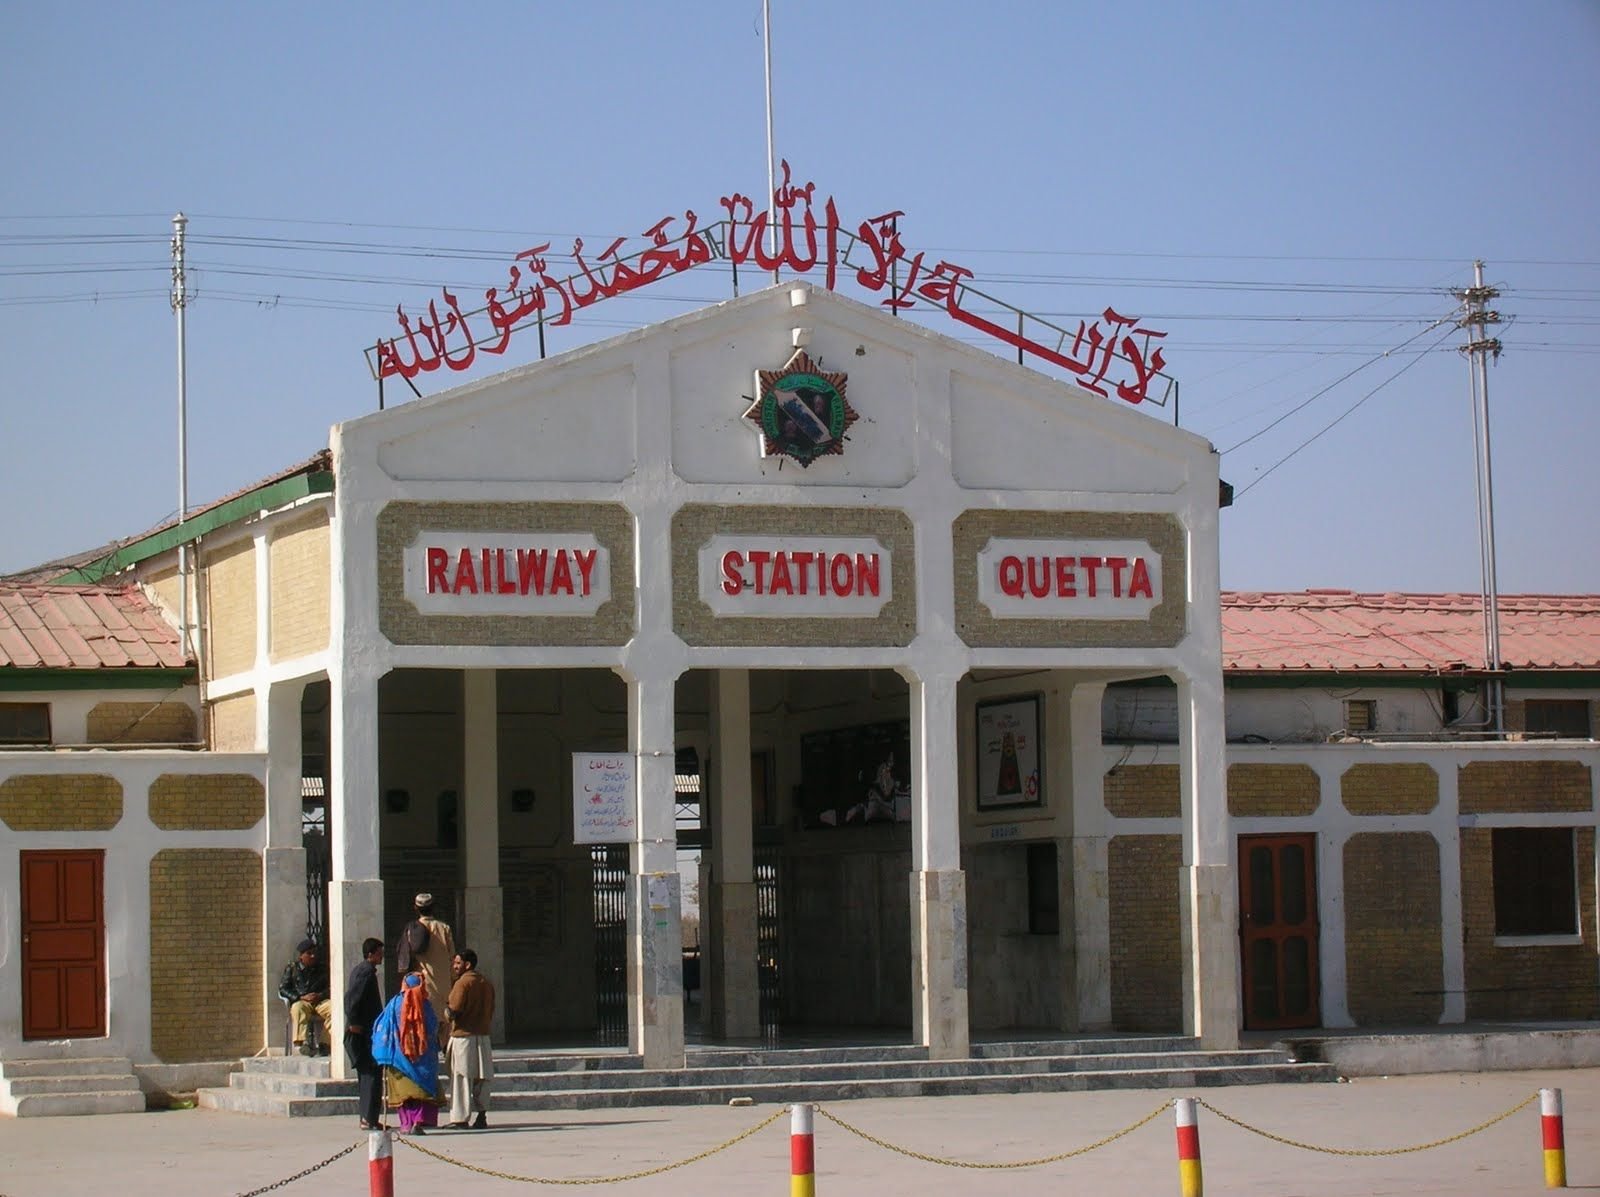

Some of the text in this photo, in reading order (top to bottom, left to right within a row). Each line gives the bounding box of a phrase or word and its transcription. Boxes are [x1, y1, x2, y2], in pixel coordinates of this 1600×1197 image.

[425, 547, 1154, 600] RAILWAY STATION QUETTA
